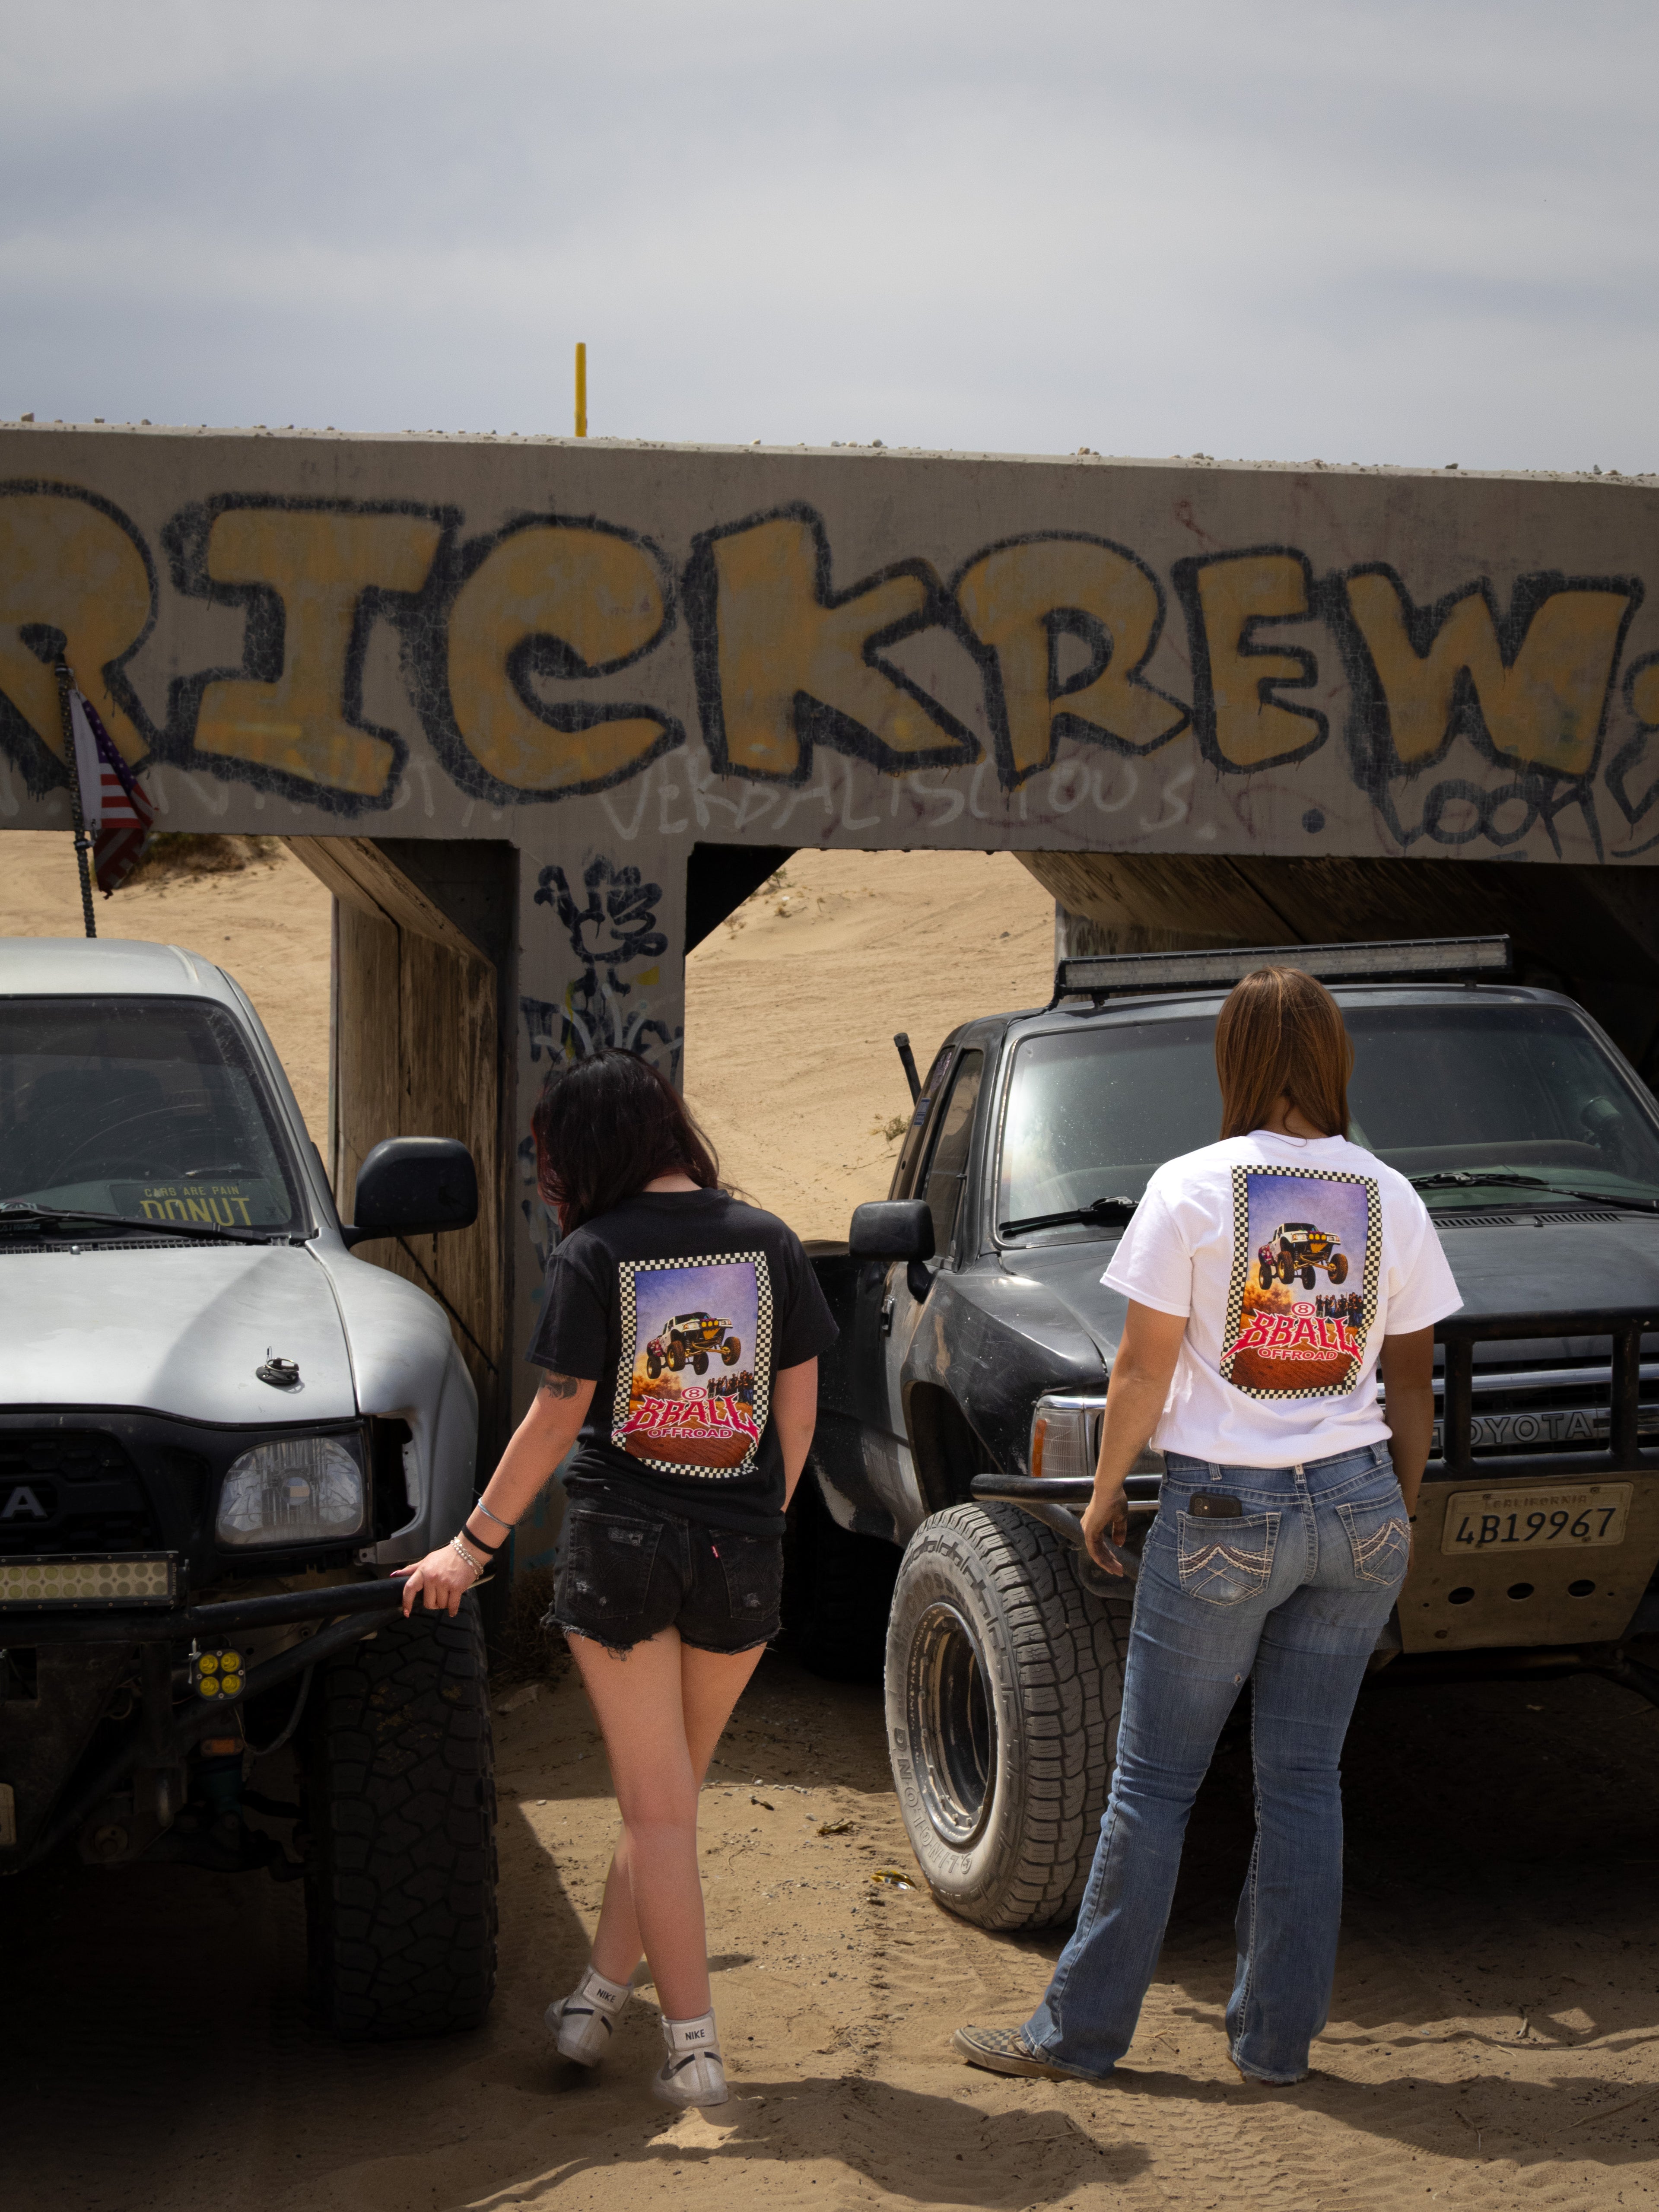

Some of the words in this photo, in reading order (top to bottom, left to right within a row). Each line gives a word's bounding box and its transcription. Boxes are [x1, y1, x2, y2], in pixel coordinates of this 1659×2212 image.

[144, 1187, 177, 1197] CARS
[184, 1187, 207, 1195] ARE
[211, 1186, 239, 1195] PAIN
[140, 1198, 252, 1226] DONUT
[1258, 1348, 1338, 1360] OFFROAD
[648, 1427, 733, 1439] OFFROAD
[1493, 1495, 1588, 1508] CALIFORNIA
[1456, 1507, 1616, 1544] 4B19967
[596, 1988, 616, 2003] NIKE
[685, 2029, 705, 2041] NIKE
